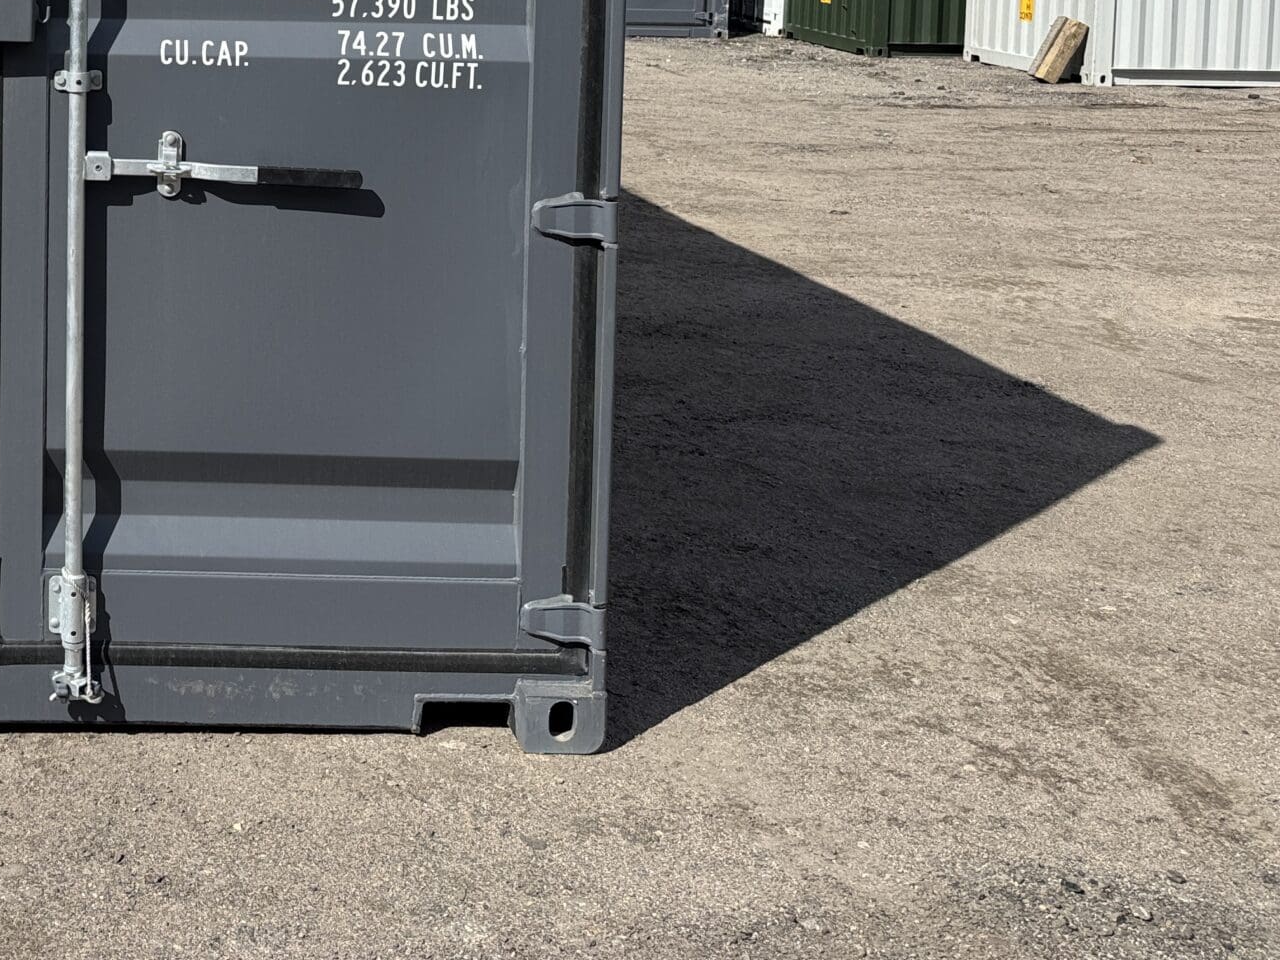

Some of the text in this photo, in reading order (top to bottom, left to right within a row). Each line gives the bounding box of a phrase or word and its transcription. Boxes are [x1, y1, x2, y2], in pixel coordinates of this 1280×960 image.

[337, 30, 484, 60] 74.27 CU.M.
[337, 58, 482, 90] 2,623 CU.FT.
